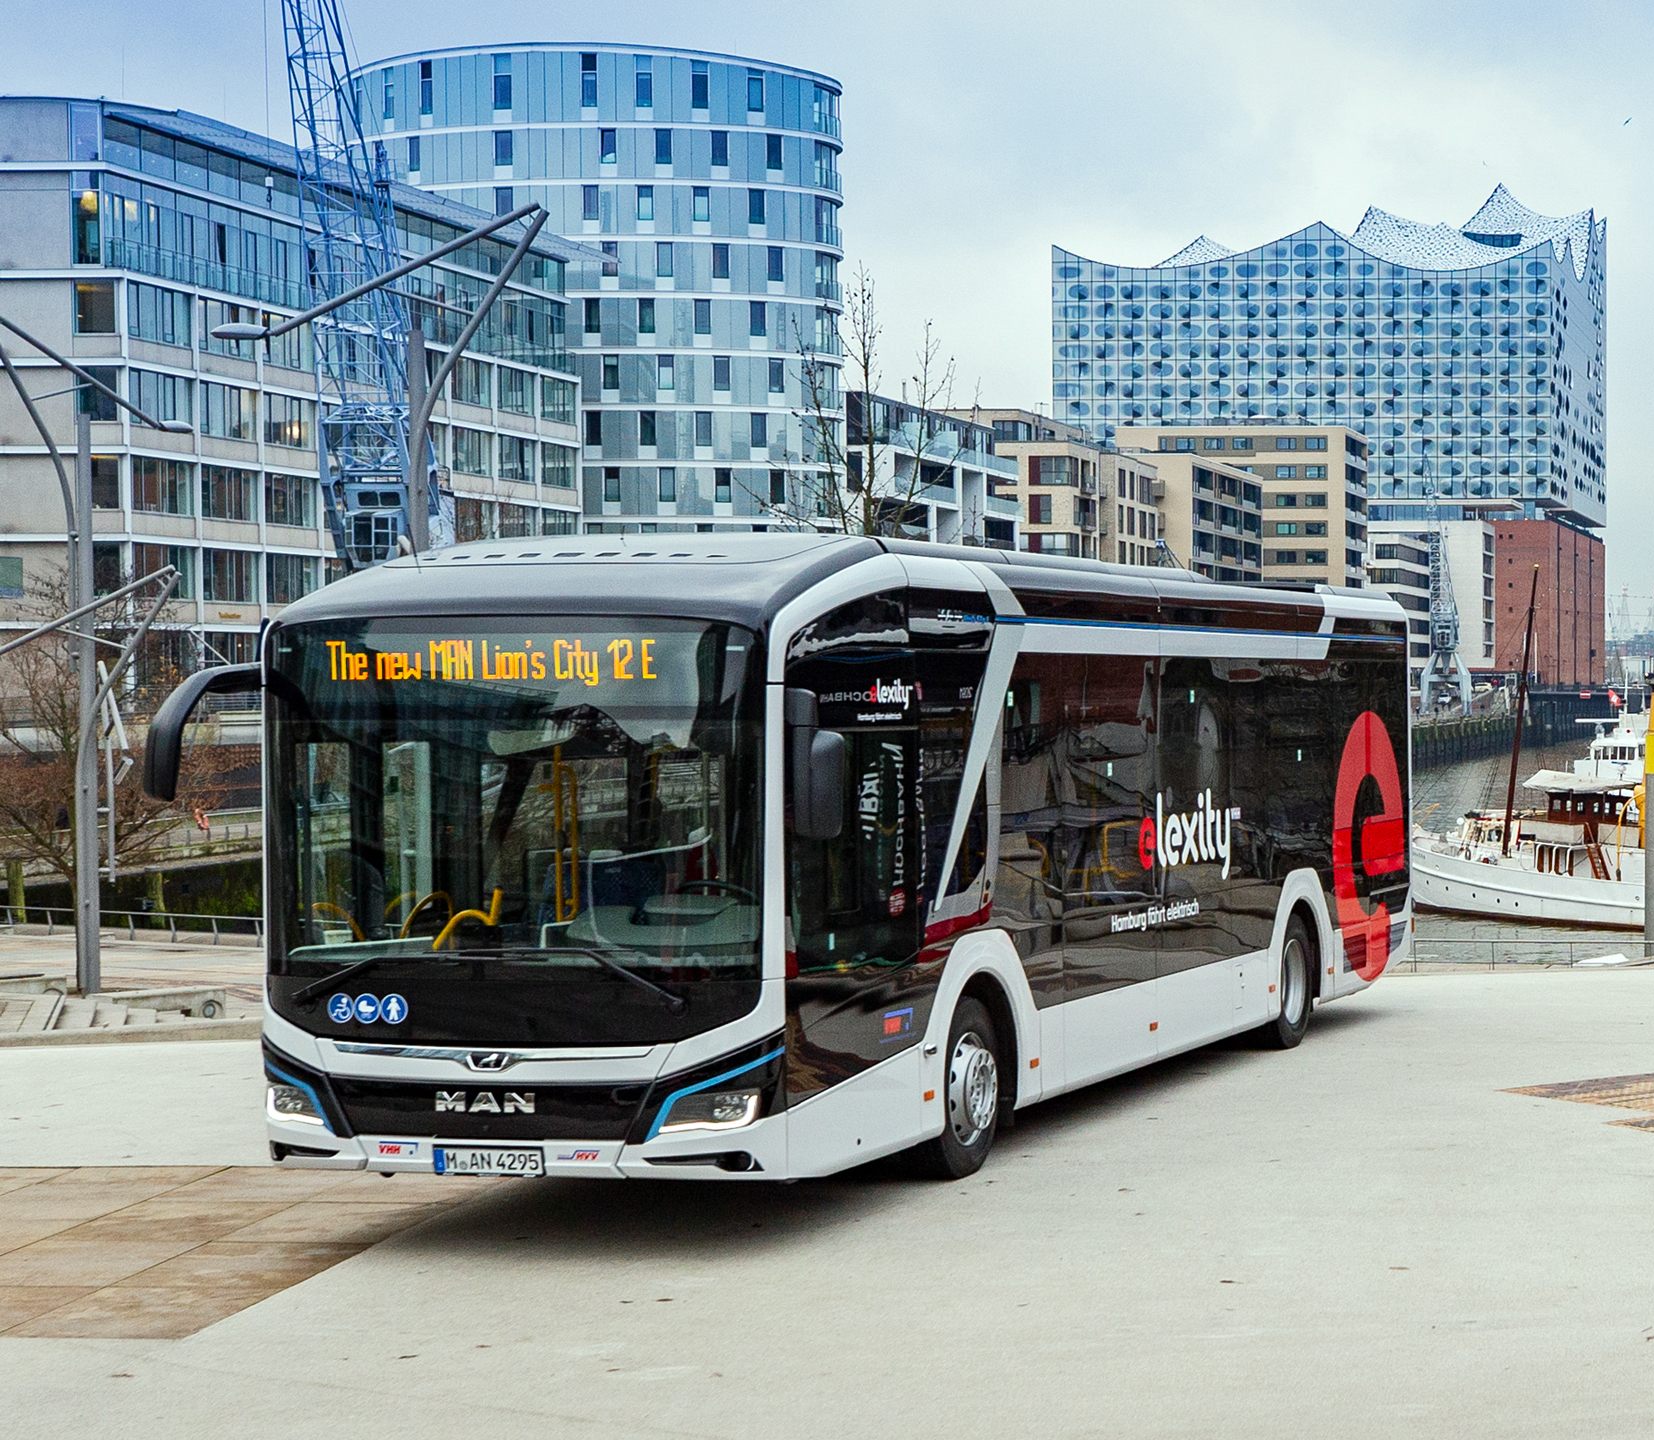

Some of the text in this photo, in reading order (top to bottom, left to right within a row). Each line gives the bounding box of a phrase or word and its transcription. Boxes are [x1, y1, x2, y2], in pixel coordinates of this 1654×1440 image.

[326, 639, 657, 687] The new MAN Lion's City 12 E
[870, 678, 909, 710] elexity
[1138, 787, 1231, 880] elexity
[1111, 898, 1200, 933] Hamburg fährt elektrisch
[435, 1090, 536, 1114] MAN
[446, 1152, 540, 1172] M AN 4295
